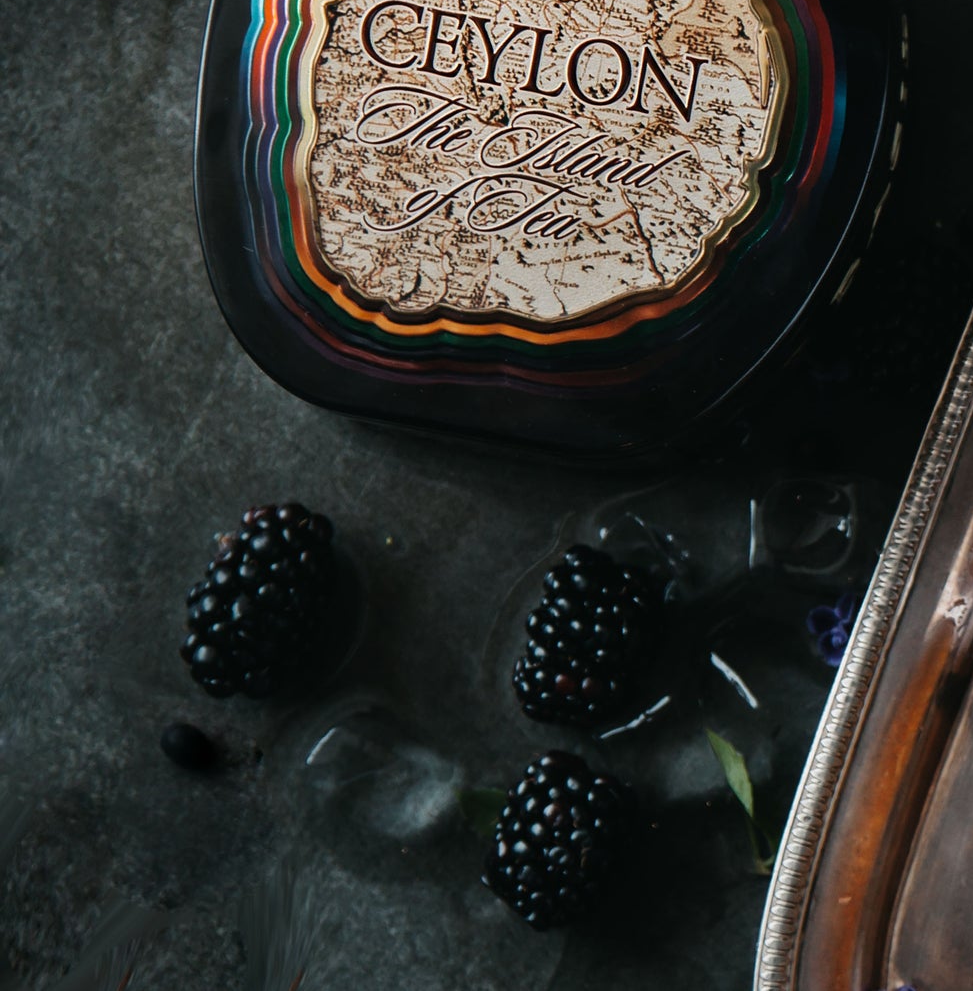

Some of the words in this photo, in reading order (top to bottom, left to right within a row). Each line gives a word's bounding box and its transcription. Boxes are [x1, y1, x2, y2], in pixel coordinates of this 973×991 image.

[361, 1, 709, 122] CEYLON
[356, 86, 479, 152] The
[480, 110, 690, 189] Island
[363, 175, 502, 232] of
[466, 173, 587, 240] Tea
